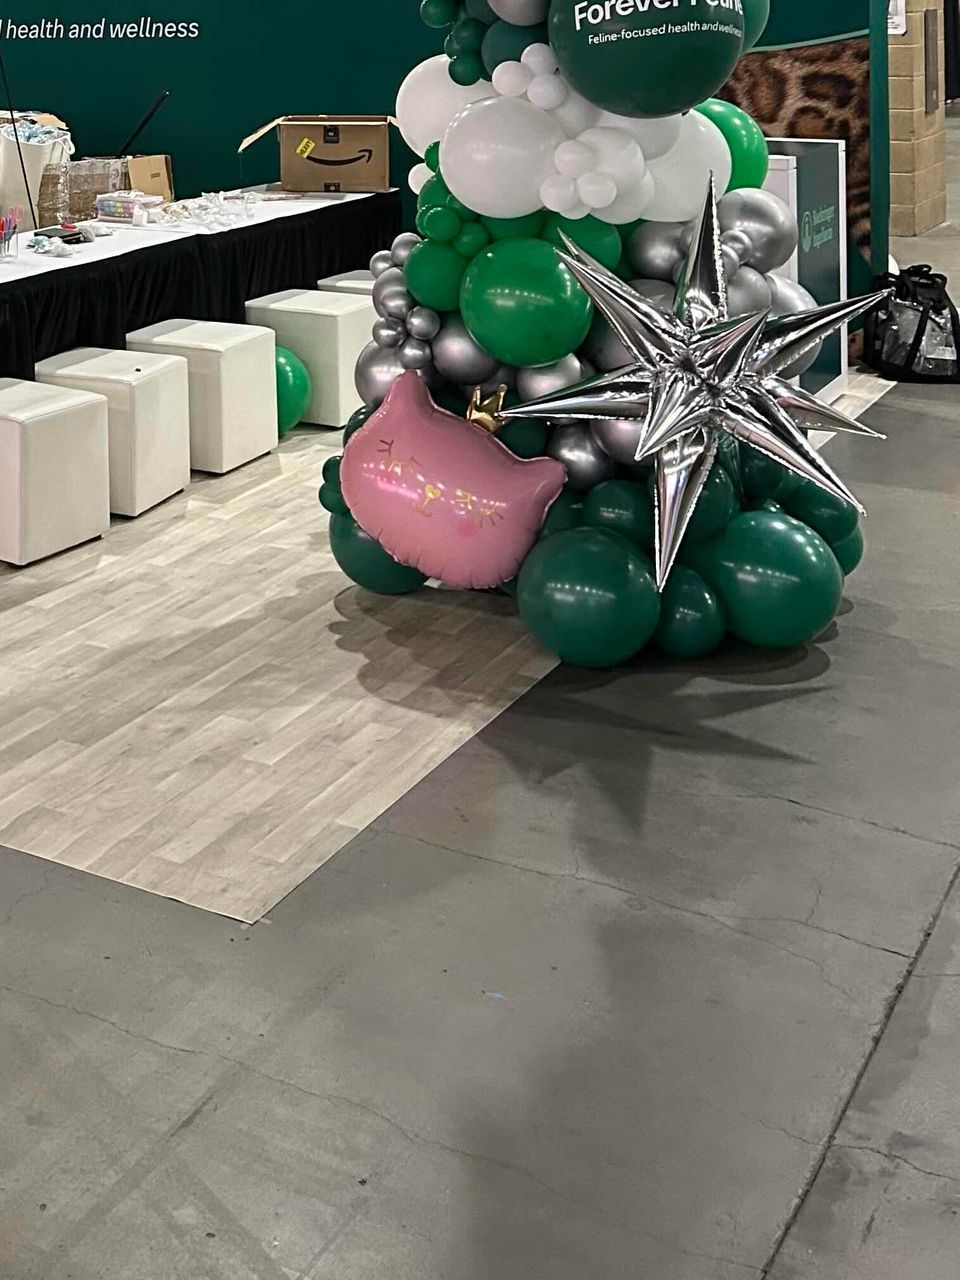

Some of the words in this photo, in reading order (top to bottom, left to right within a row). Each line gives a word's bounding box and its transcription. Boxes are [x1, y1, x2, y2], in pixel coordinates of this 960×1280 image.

[6, 18, 65, 39] health
[69, 18, 105, 38] and
[109, 17, 200, 38] wellness
[588, 25, 666, 44] Feline-focused
[667, 21, 701, 34] health
[701, 21, 718, 31] and
